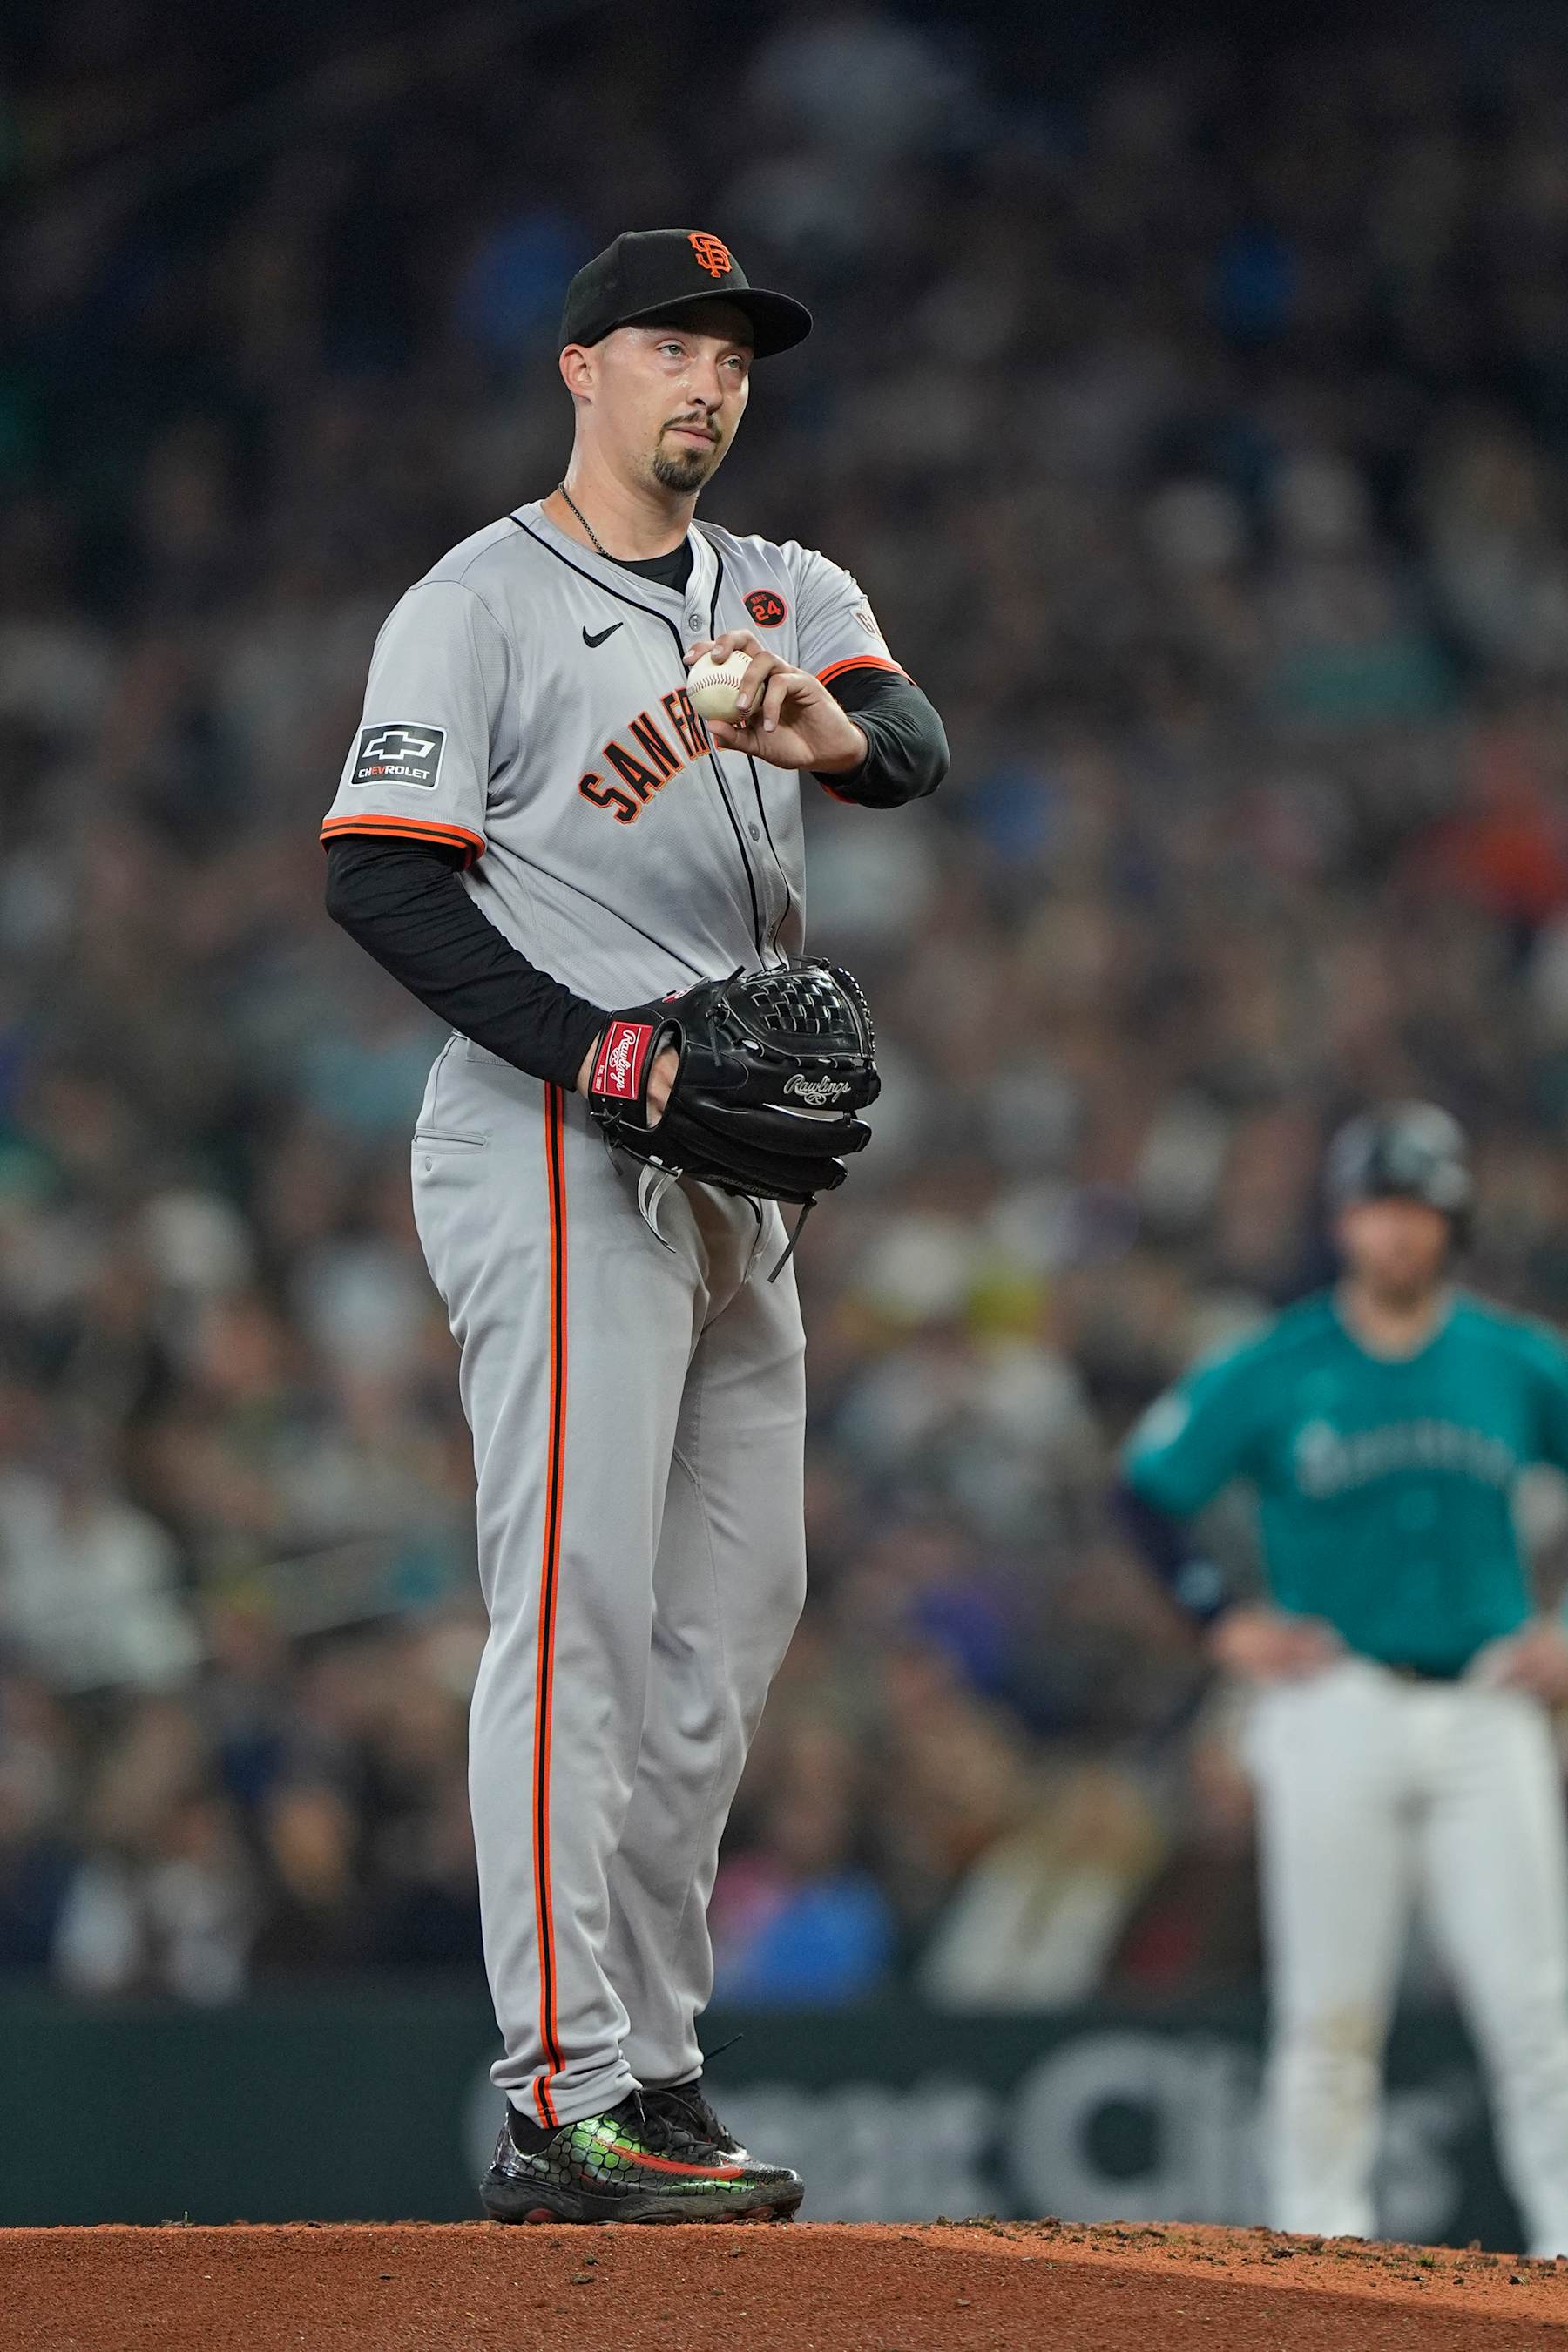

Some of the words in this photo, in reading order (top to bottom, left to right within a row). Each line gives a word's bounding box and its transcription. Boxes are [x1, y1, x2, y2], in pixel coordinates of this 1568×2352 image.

[687, 233, 733, 278] SF
[752, 599, 781, 621] 24
[358, 765, 431, 780] CHEVROLET
[578, 710, 684, 824] SAN
[660, 686, 724, 761] FR
[610, 1029, 636, 1092] Rawlings
[783, 1073, 852, 1104] Rawlings
